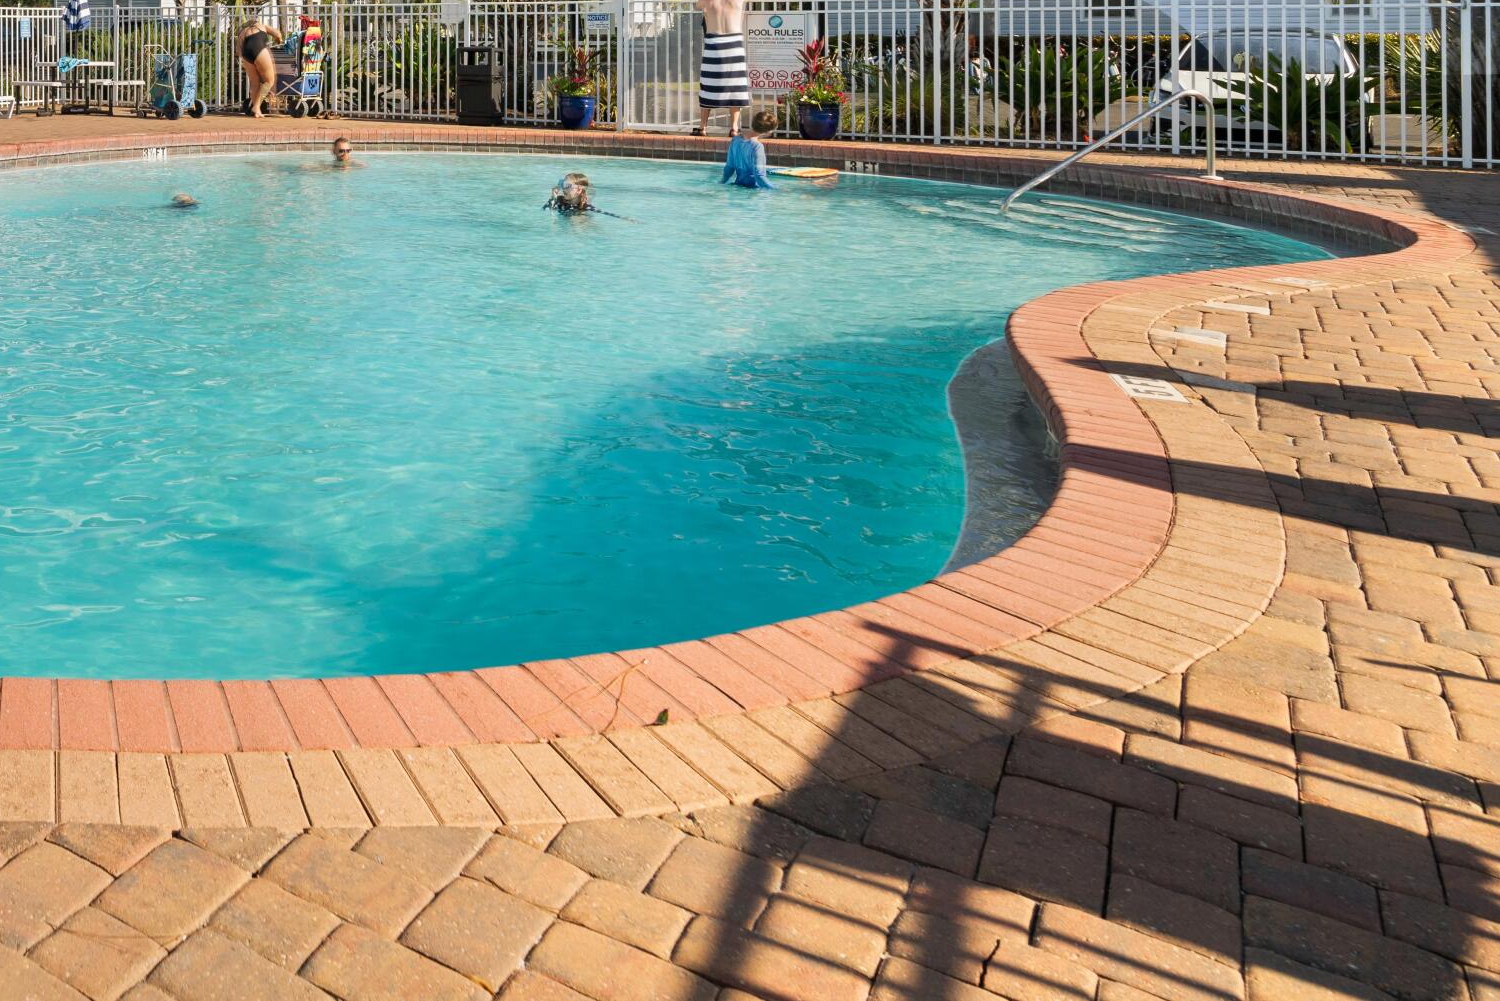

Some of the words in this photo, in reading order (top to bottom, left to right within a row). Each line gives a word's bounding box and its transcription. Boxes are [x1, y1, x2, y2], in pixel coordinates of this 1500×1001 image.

[751, 80, 766, 88] NO
[155, 147, 166, 156] FT
[850, 160, 857, 171] 3
[863, 161, 877, 174] FT
